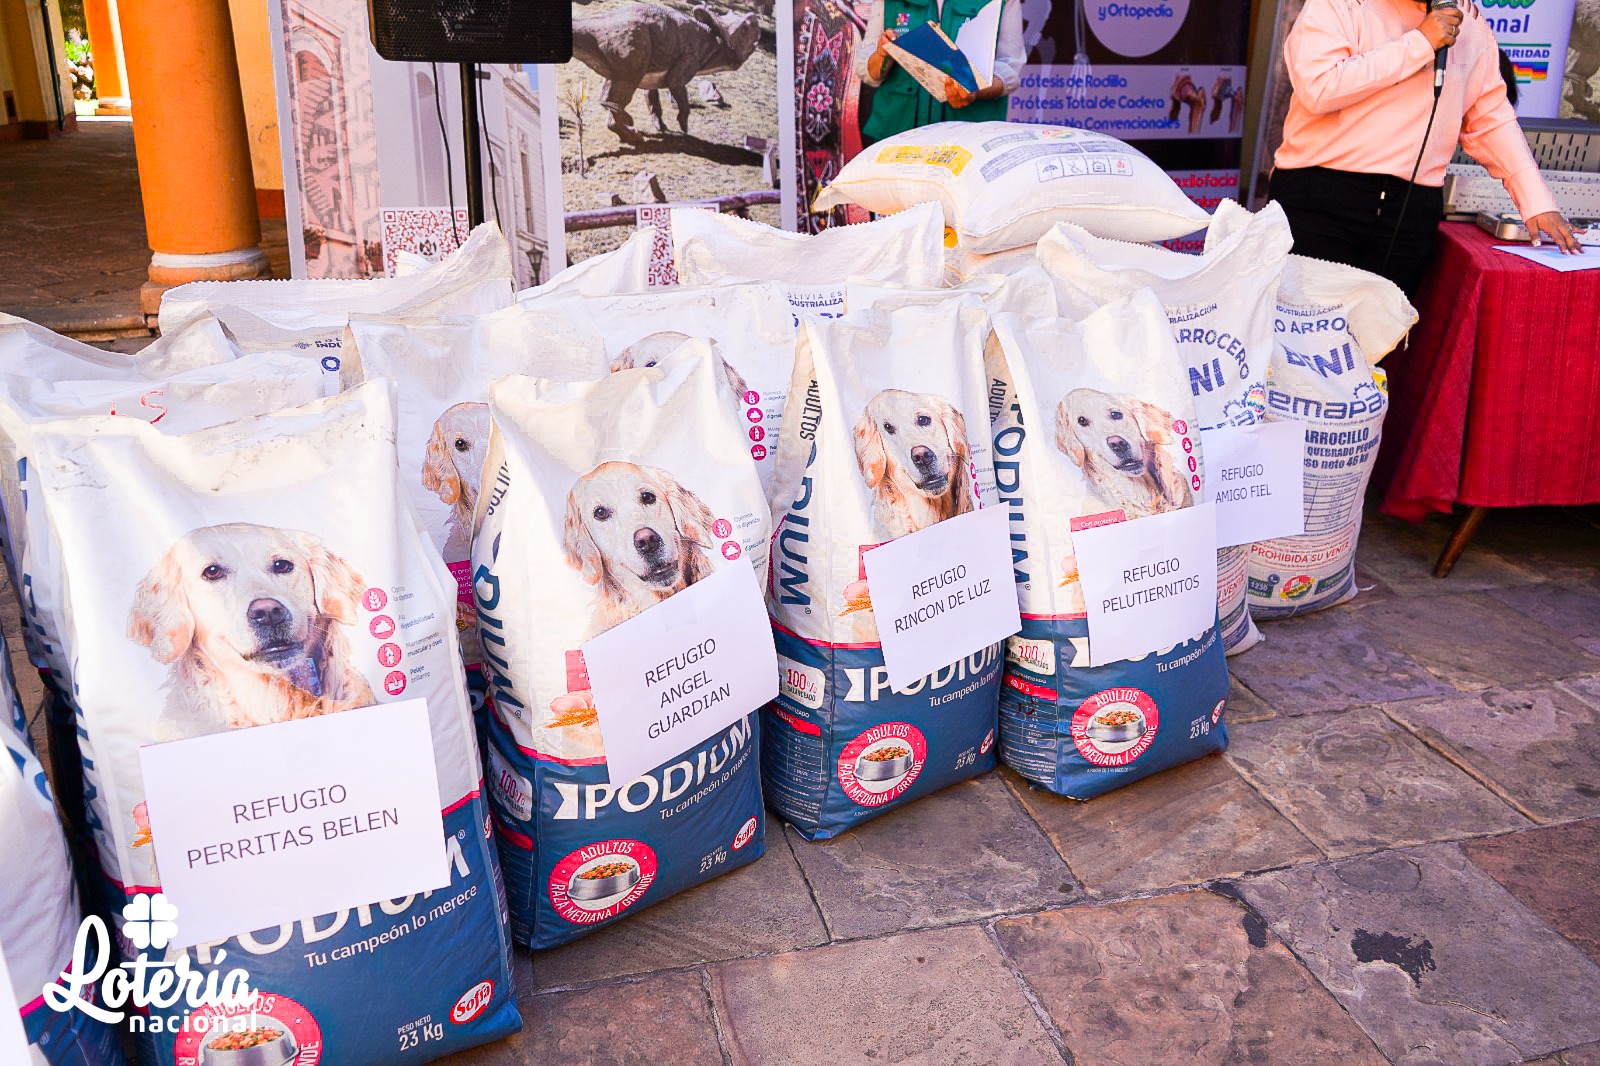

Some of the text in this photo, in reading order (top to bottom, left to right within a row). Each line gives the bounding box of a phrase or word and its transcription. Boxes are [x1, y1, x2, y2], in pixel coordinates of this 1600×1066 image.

[1098, 6, 1106, 21] y
[1019, 74, 1064, 88] rótesis
[1066, 74, 1083, 88] de
[1011, 95, 1165, 110] Prótesis Total de Cadera
[1084, 117, 1181, 130] Convencionales
[1174, 328, 1250, 380] RROCERO
[1221, 463, 1264, 482] REFUGIO
[1215, 484, 1272, 504] AMIGO FIEL
[1250, 544, 1308, 563] PROHIBIDA
[1311, 554, 1323, 562] SU
[912, 564, 967, 600] REFUGIO
[1123, 558, 1180, 584] REFUGIO
[894, 579, 992, 634] RINCON DE LUZ
[1102, 575, 1200, 614] PELUTIERNITOS
[644, 638, 716, 688] REFUGIO
[1156, 662, 1168, 673] Tu
[1169, 648, 1202, 670] campeón
[660, 670, 713, 709] ANGEL
[786, 668, 818, 694] 100%
[929, 696, 941, 707] Tu
[942, 681, 980, 704] campeón
[648, 683, 731, 739] GUARDIAN
[1094, 689, 1140, 708] ADULTOS
[866, 724, 911, 744] ADULTOS
[1190, 721, 1210, 739] 23 Kg
[1081, 745, 1123, 766] MEDIANA
[1130, 724, 1158, 757] GRANDE
[585, 714, 752, 820] PODIUM
[660, 808, 673, 820] Tu
[675, 779, 720, 813] campeón
[721, 771, 730, 784] lo
[840, 763, 852, 790] RAZA
[849, 785, 889, 806] MEDIANA
[898, 759, 924, 794] GRANDE
[233, 784, 347, 824] REFUGIO
[187, 807, 399, 869] PERRITAS BELEN
[580, 840, 636, 862] ADULTOS
[699, 851, 727, 874] 23 Kg
[551, 883, 568, 914] RAZA
[565, 905, 612, 924] MEDIANA
[622, 869, 655, 908] GRANDE
[303, 885, 478, 968] Tu campeón lo merece
[455, 984, 492, 1018] Sofía
[397, 1014, 431, 1035] PESO NETO
[399, 1022, 444, 1052] 23 Kg
